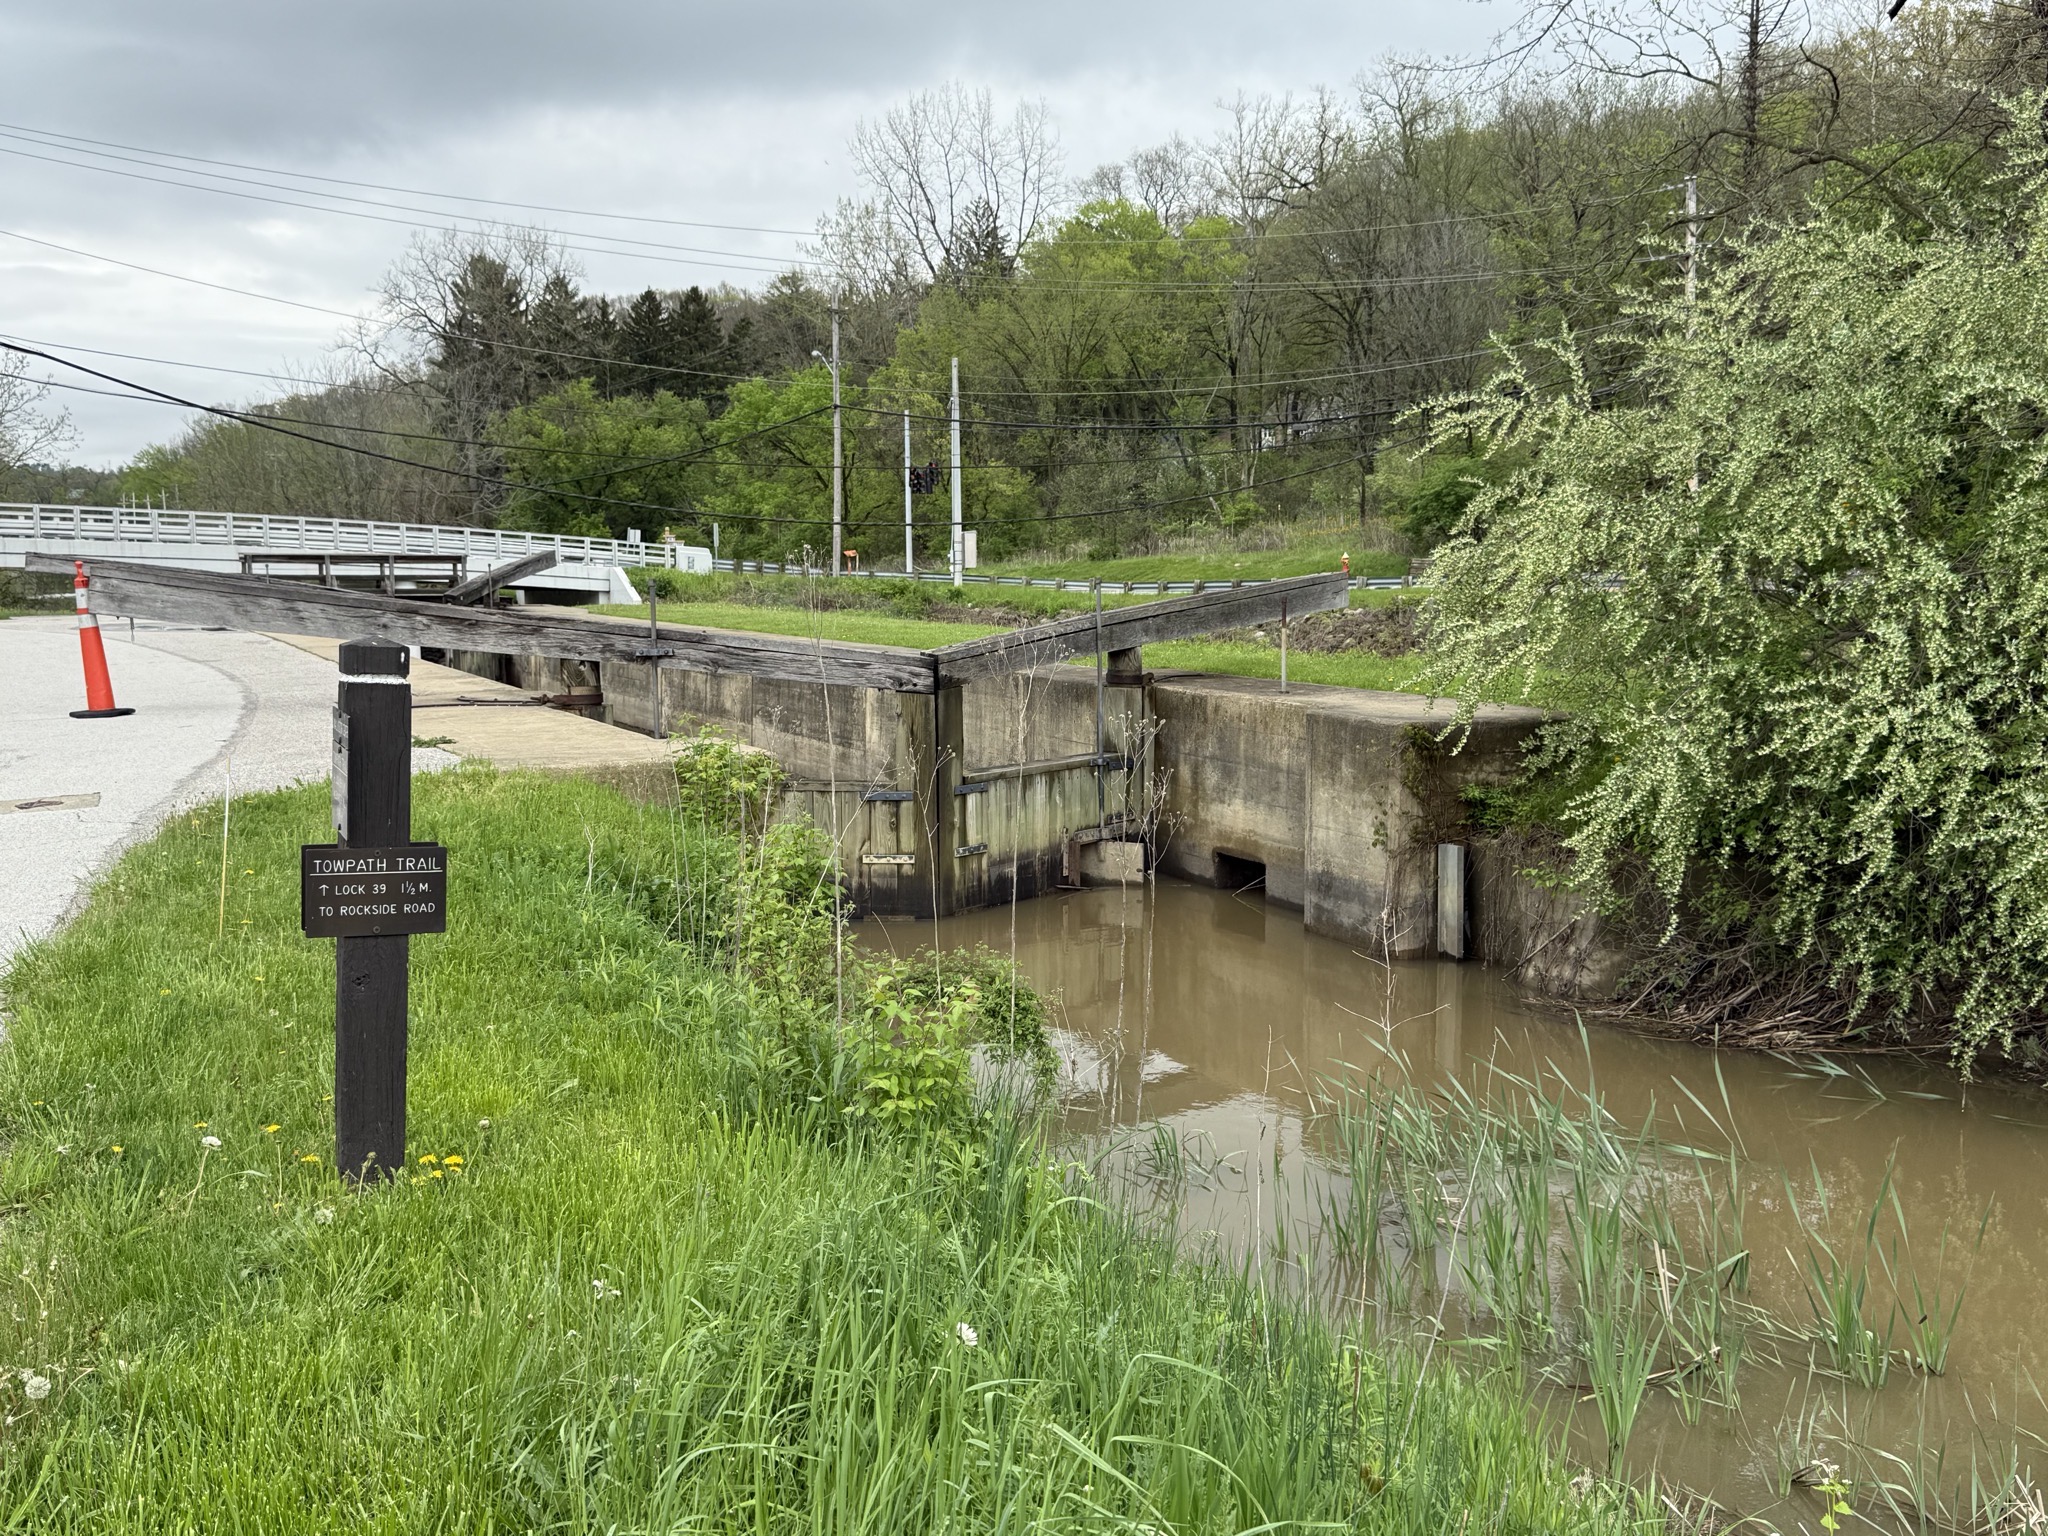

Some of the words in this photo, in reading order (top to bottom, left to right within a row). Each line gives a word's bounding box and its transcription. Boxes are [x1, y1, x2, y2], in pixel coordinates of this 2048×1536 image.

[313, 858, 387, 873] TOWPATH
[396, 857, 441, 871] TRAIL
[335, 884, 366, 896] LOCK
[372, 883, 387, 894] 39
[419, 882, 432, 893] M.
[319, 906, 334, 917] TO
[340, 904, 397, 916] ROCKSIDE
[404, 902, 436, 914] ROAD
